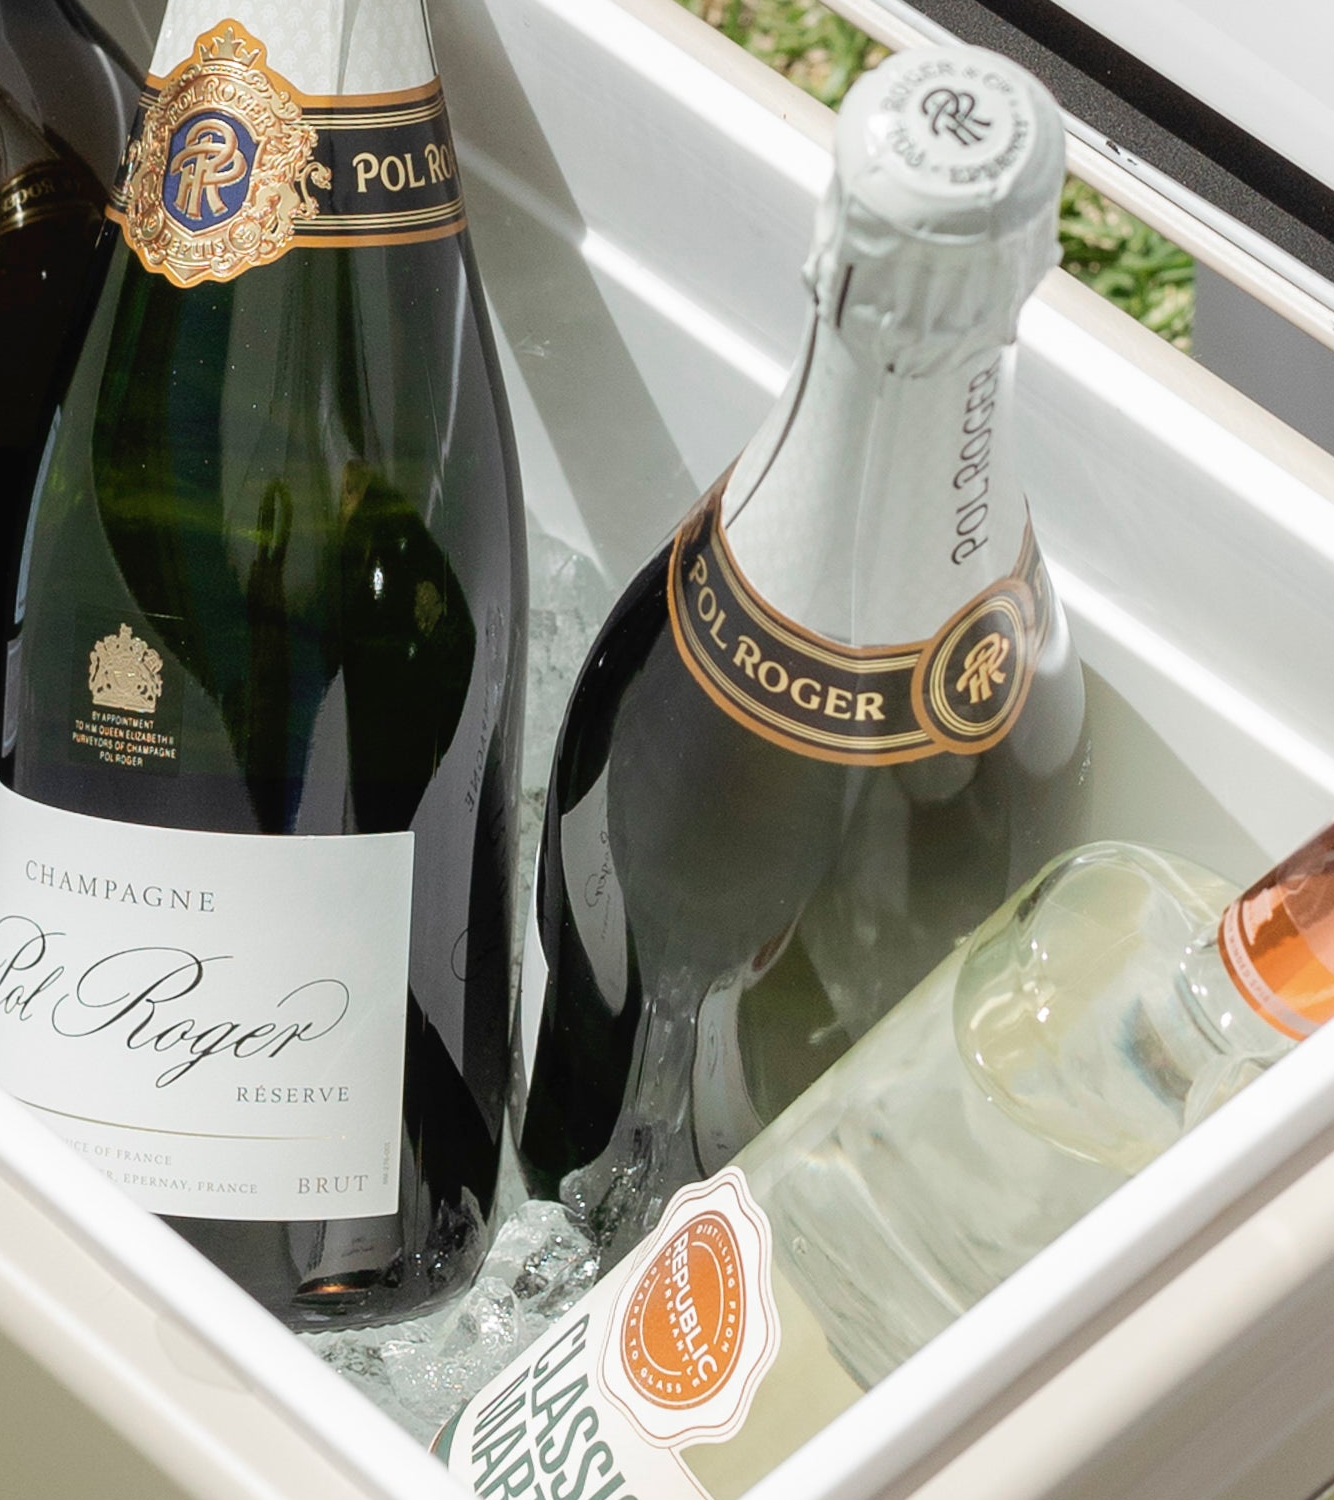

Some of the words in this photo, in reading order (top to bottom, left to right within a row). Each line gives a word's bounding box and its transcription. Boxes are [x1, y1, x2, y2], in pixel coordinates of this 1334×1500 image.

[169, 87, 203, 126] POL
[203, 77, 277, 136] ROGER
[352, 151, 425, 193] POL
[158, 230, 226, 260] DEPUIS
[952, 354, 1003, 490] ROGER
[951, 476, 989, 565] POL
[688, 555, 727, 650] POL
[732, 634, 886, 721] ROGER
[75, 720, 84, 731] TO
[99, 725, 124, 738] QUEEN
[126, 730, 168, 745] ELIZABETH
[91, 710, 100, 721] BY
[102, 712, 154, 730] APPOINTMENT
[72, 732, 113, 750] PURVEYORS
[114, 741, 124, 751] OF
[127, 742, 177, 760] CHAMPAGNE
[99, 750, 113, 762] POL
[115, 753, 143, 767] ROGER
[25, 859, 216, 913] CHAMPAGNE
[52, 947, 350, 1089] Roger
[236, 1083, 350, 1103] RÉSERVE
[94, 1144, 111, 1157] OF
[116, 1149, 172, 1167] FRANCE
[197, 1180, 258, 1195] FRANCE
[297, 1173, 369, 1195] BRUT
[671, 1231, 718, 1382] REPUBLIC
[696, 1223, 736, 1289] DISTILLING
[721, 1300, 736, 1353] FROM
[664, 1277, 701, 1388] FREMANTLE
[629, 1338, 639, 1361] TO
[640, 1367, 682, 1394] GLASS
